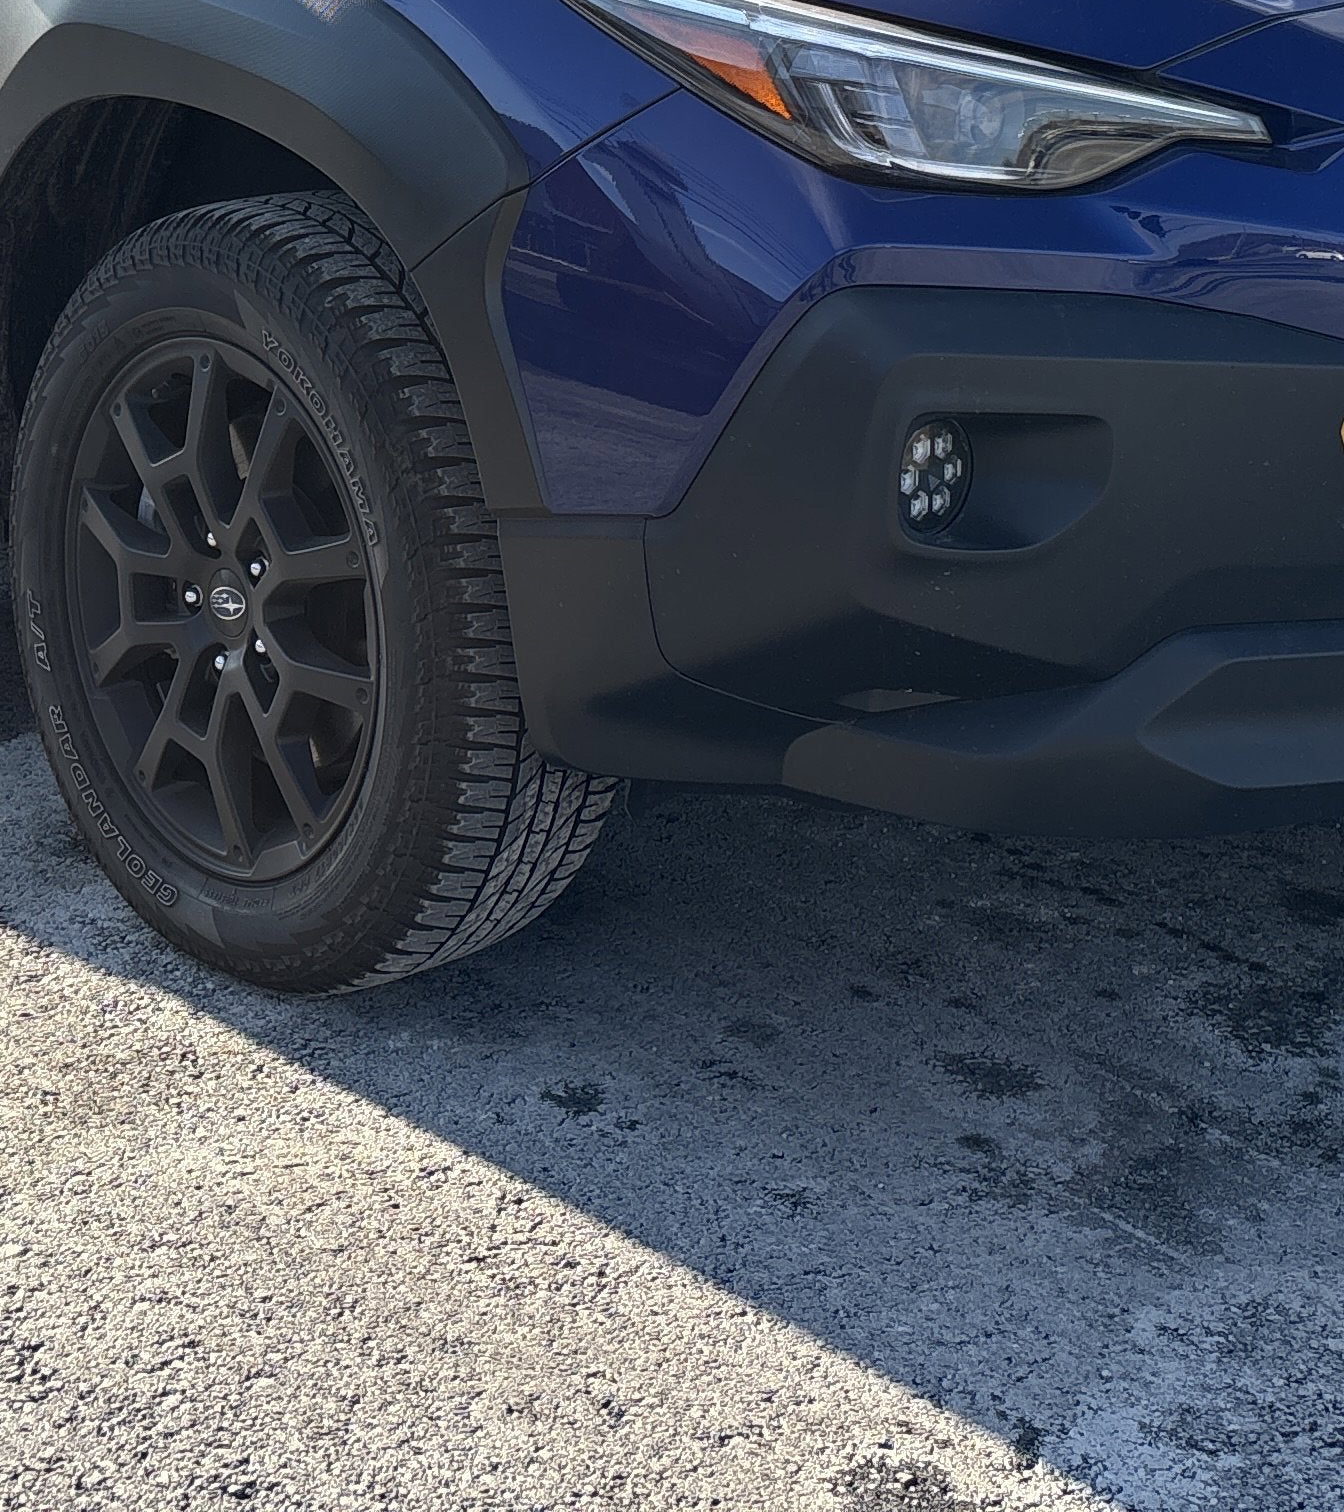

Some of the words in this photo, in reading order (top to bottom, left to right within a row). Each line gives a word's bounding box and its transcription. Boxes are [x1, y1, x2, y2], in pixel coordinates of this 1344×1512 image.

[261, 328, 379, 546] YOKOHAMA
[27, 589, 51, 672] A/T
[49, 705, 178, 907] GEOLANDAR
